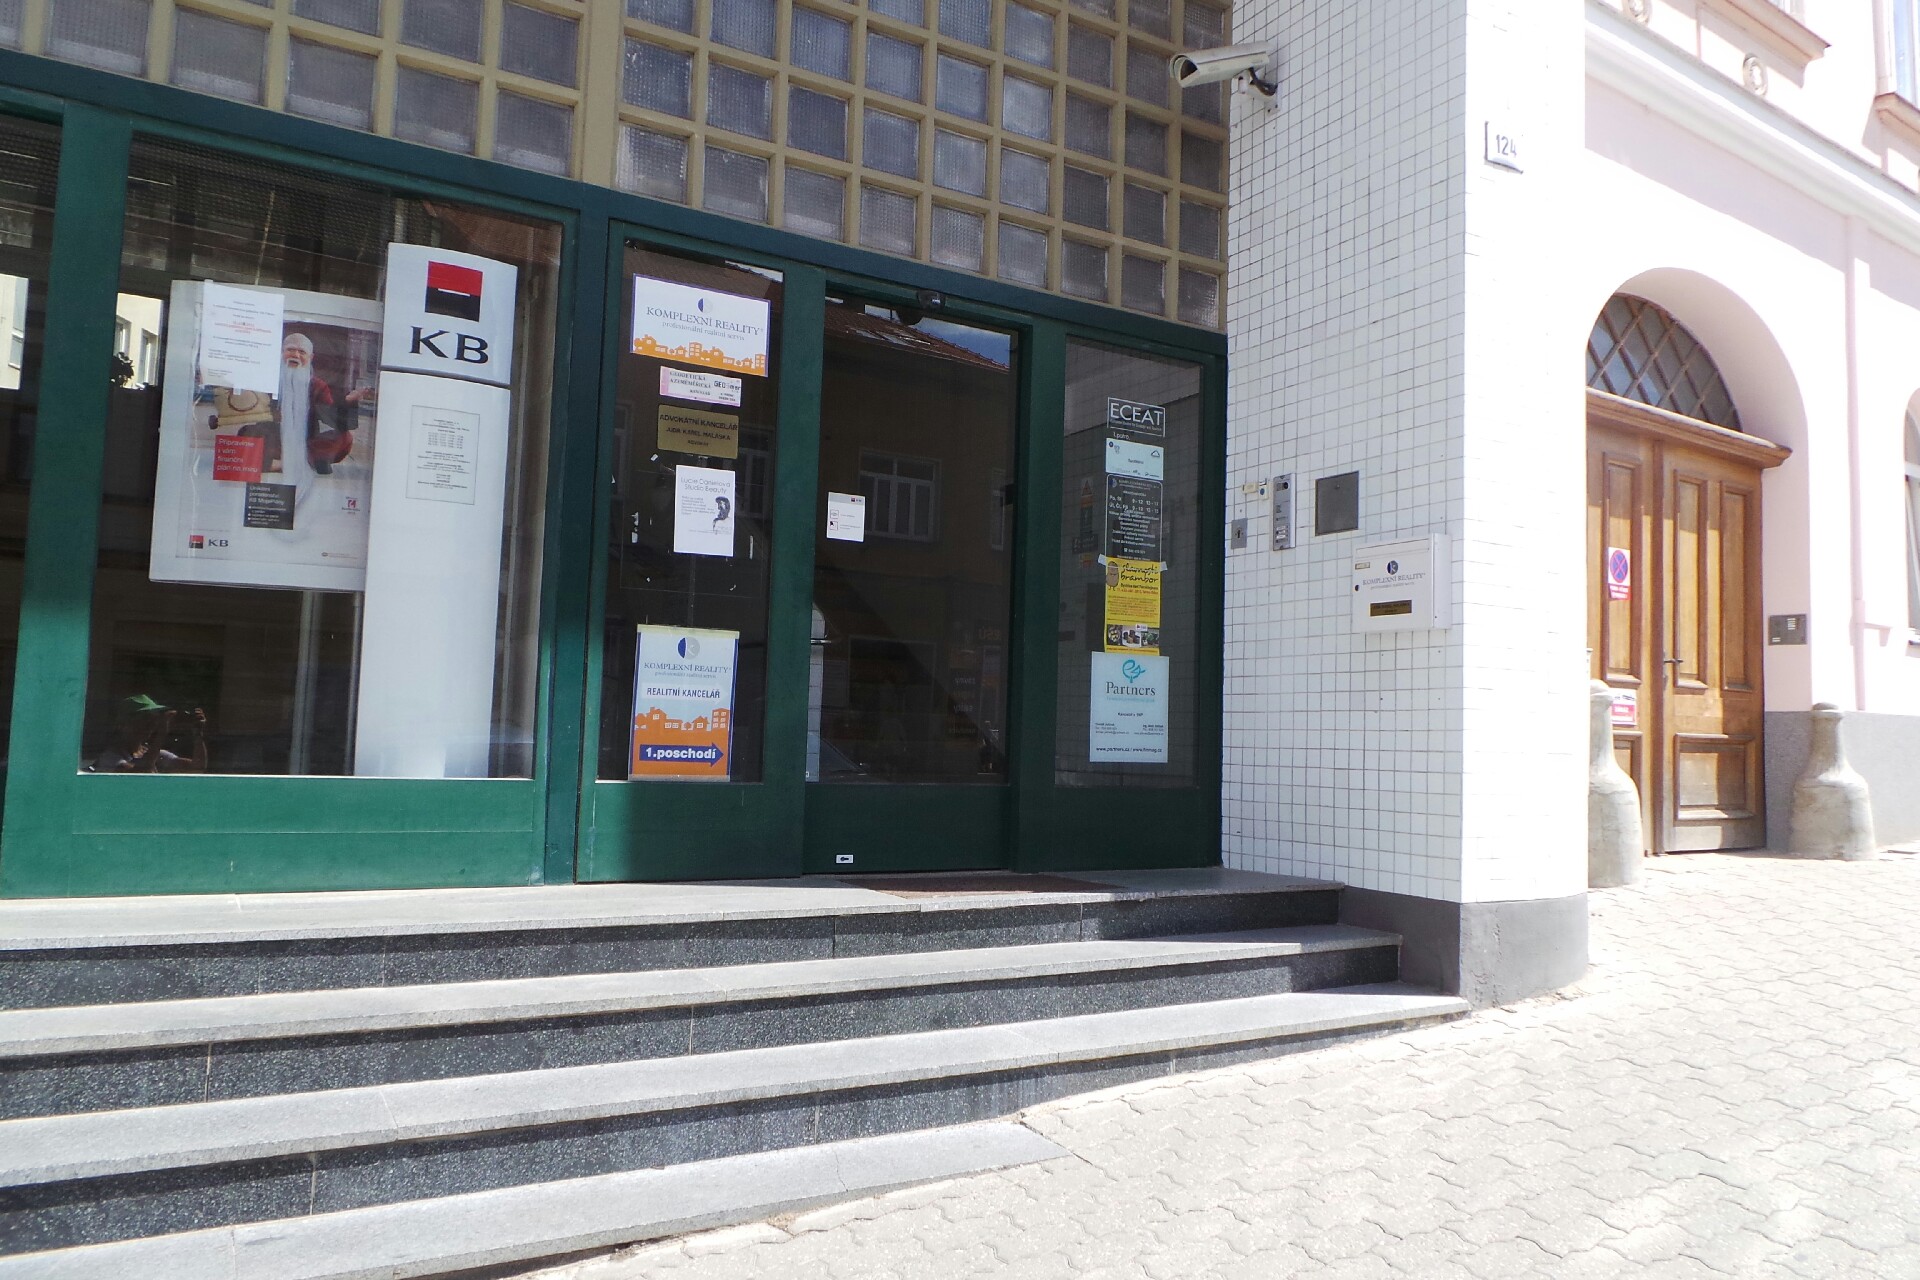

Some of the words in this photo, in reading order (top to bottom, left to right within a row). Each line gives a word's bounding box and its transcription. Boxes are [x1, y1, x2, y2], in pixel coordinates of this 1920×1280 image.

[1496, 134, 1517, 158] 124
[646, 306, 712, 327] KOMPLEXNÍ
[715, 319, 760, 335] REALITY
[662, 321, 703, 333] profesionální
[409, 325, 489, 364] KB
[1110, 402, 1163, 426] ECEAT
[208, 538, 229, 548] KB
[1362, 577, 1397, 585] KOMPLEXNÍ
[1397, 573, 1423, 581] REALITY
[644, 662, 692, 672] KOMPLEXNÍ
[694, 664, 729, 674] REALITY
[646, 686, 680, 697] REALITNÍ
[682, 688, 720, 699] KANCELÁŘ
[1106, 681, 1156, 696] Partners
[645, 747, 717, 760] 1.poschodí
